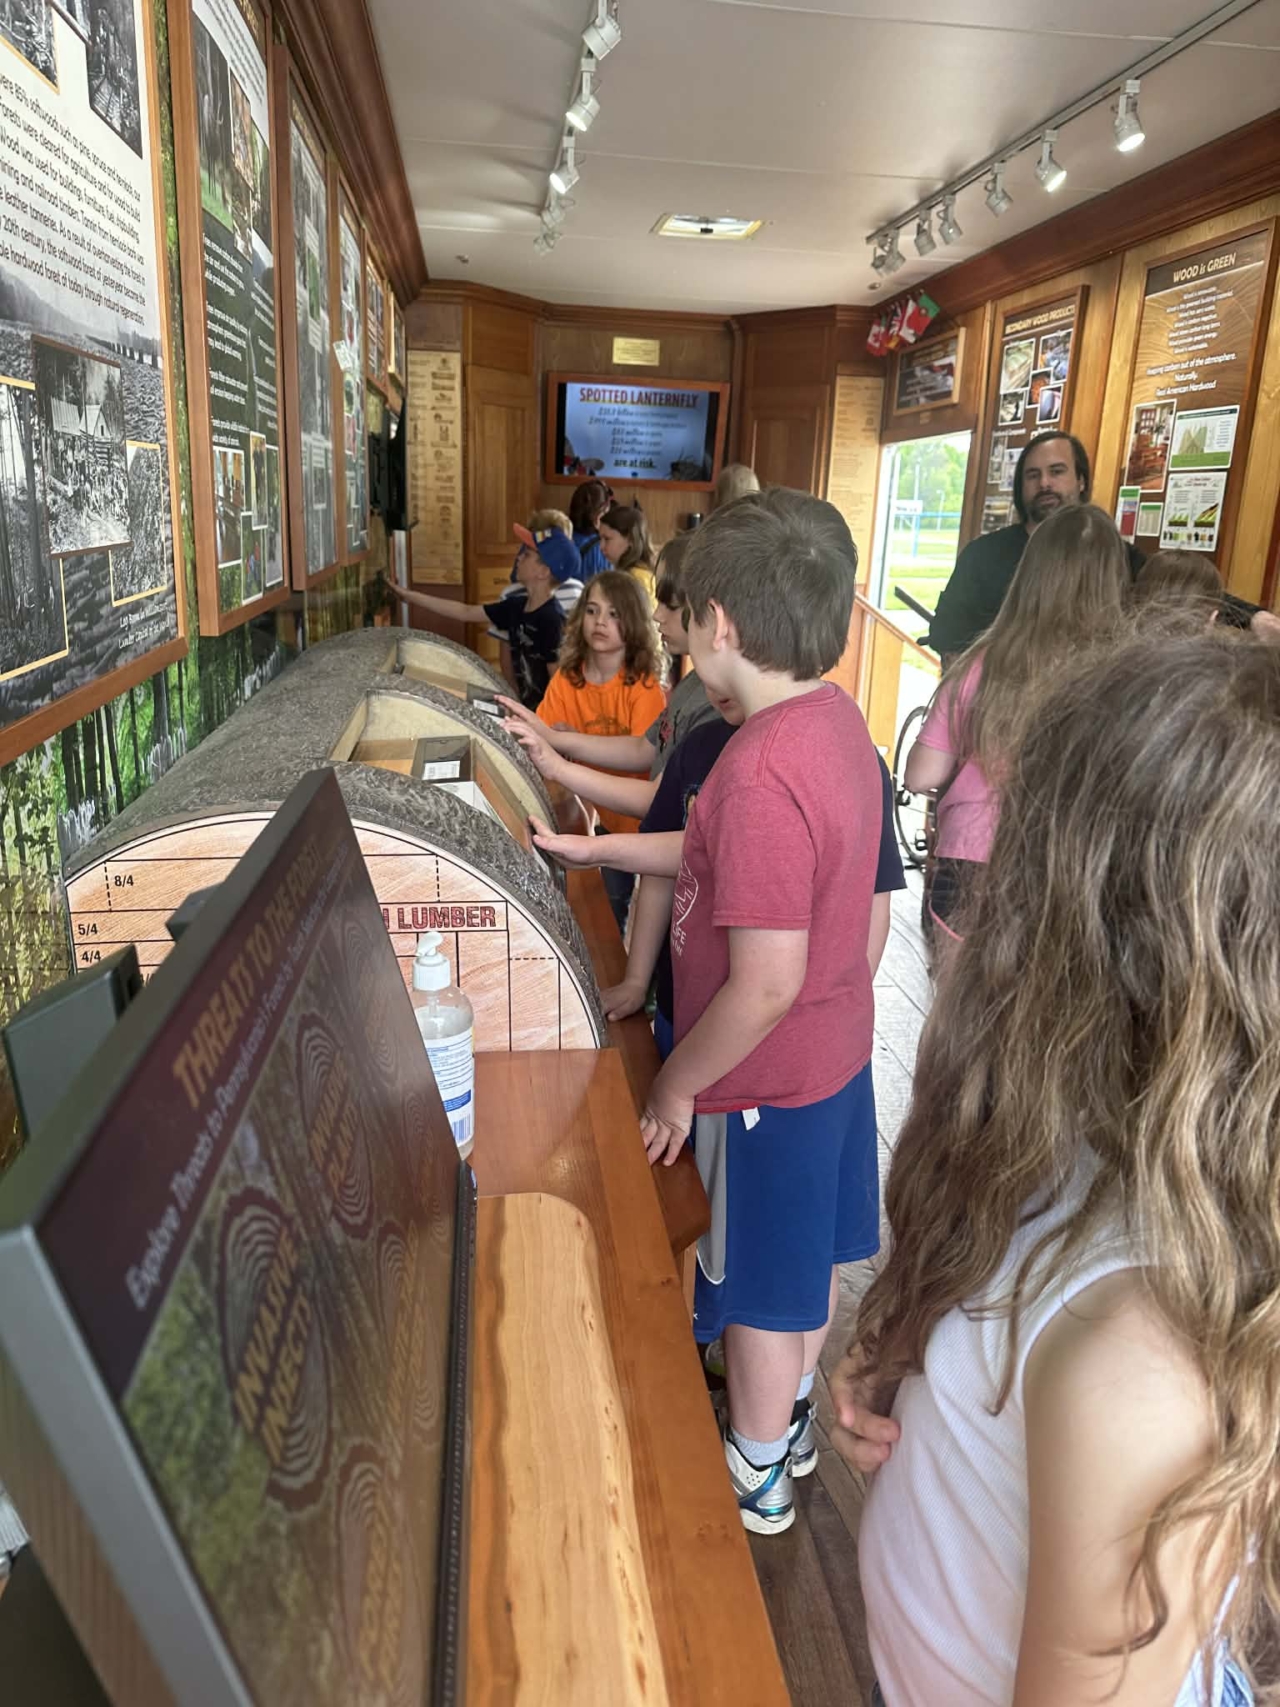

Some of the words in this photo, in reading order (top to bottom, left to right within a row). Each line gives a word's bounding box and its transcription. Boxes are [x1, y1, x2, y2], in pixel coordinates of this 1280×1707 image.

[30, 98, 59, 133] softwoods
[60, 124, 71, 144] such
[72, 136, 78, 149] as
[107, 166, 115, 181] and
[20, 146, 33, 165] was
[35, 156, 48, 176] used
[50, 162, 58, 182] for
[22, 120, 38, 142] were
[40, 130, 60, 160] cleared
[70, 158, 96, 188] agriculture
[98, 180, 106, 196] and
[114, 194, 125, 211] wood
[130, 204, 140, 223] build
[4, 184, 28, 215] leather
[60, 220, 66, 238] As
[72, 232, 86, 250] result
[86, 238, 91, 253] of
[20, 173, 34, 192] and
[35, 182, 58, 208] railroad
[80, 210, 96, 233] Tannin
[98, 222, 108, 242] from
[2, 214, 20, 238] 20th
[21, 227, 46, 254] century,
[46, 238, 57, 258] the
[57, 246, 82, 271] softwood
[96, 267, 101, 282] of
[9, 244, 43, 276] hardwood
[62, 272, 67, 287] of
[68, 275, 84, 298] today
[84, 283, 102, 306] through
[104, 294, 119, 313] natural
[1173, 265, 1199, 283] WOOD
[1207, 252, 1237, 272] GREEN
[579, 387, 628, 404] SPOTTED
[630, 391, 699, 408] LANTERNFLY
[613, 459, 627, 468] are
[629, 458, 638, 468] at
[639, 457, 657, 469] risk.
[114, 874, 134, 887] 8/4
[78, 923, 98, 936] 5/4
[244, 922, 274, 978] TO
[264, 886, 297, 943] THE
[397, 905, 496, 930] LUMBER
[81, 950, 101, 963] 4/4
[206, 1110, 222, 1139] to
[234, 1225, 299, 1434] INVASIVE
